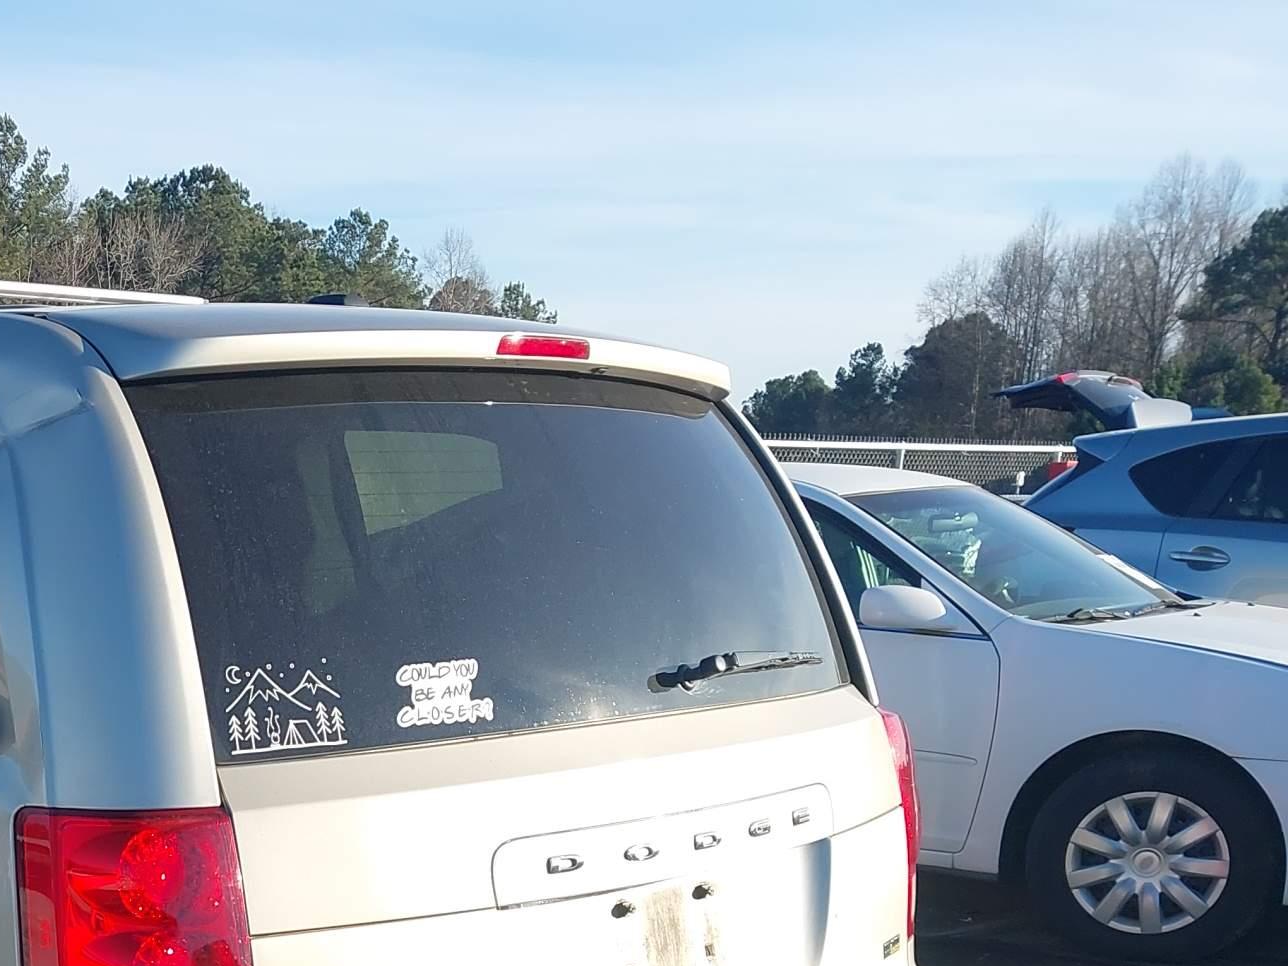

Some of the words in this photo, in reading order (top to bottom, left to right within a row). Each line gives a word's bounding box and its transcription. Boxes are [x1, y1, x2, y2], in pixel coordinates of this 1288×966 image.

[399, 665, 451, 682] COULD
[453, 663, 476, 677] YOU
[414, 687, 435, 702] BE
[441, 683, 469, 699] ANY
[546, 807, 810, 874] DODGE
